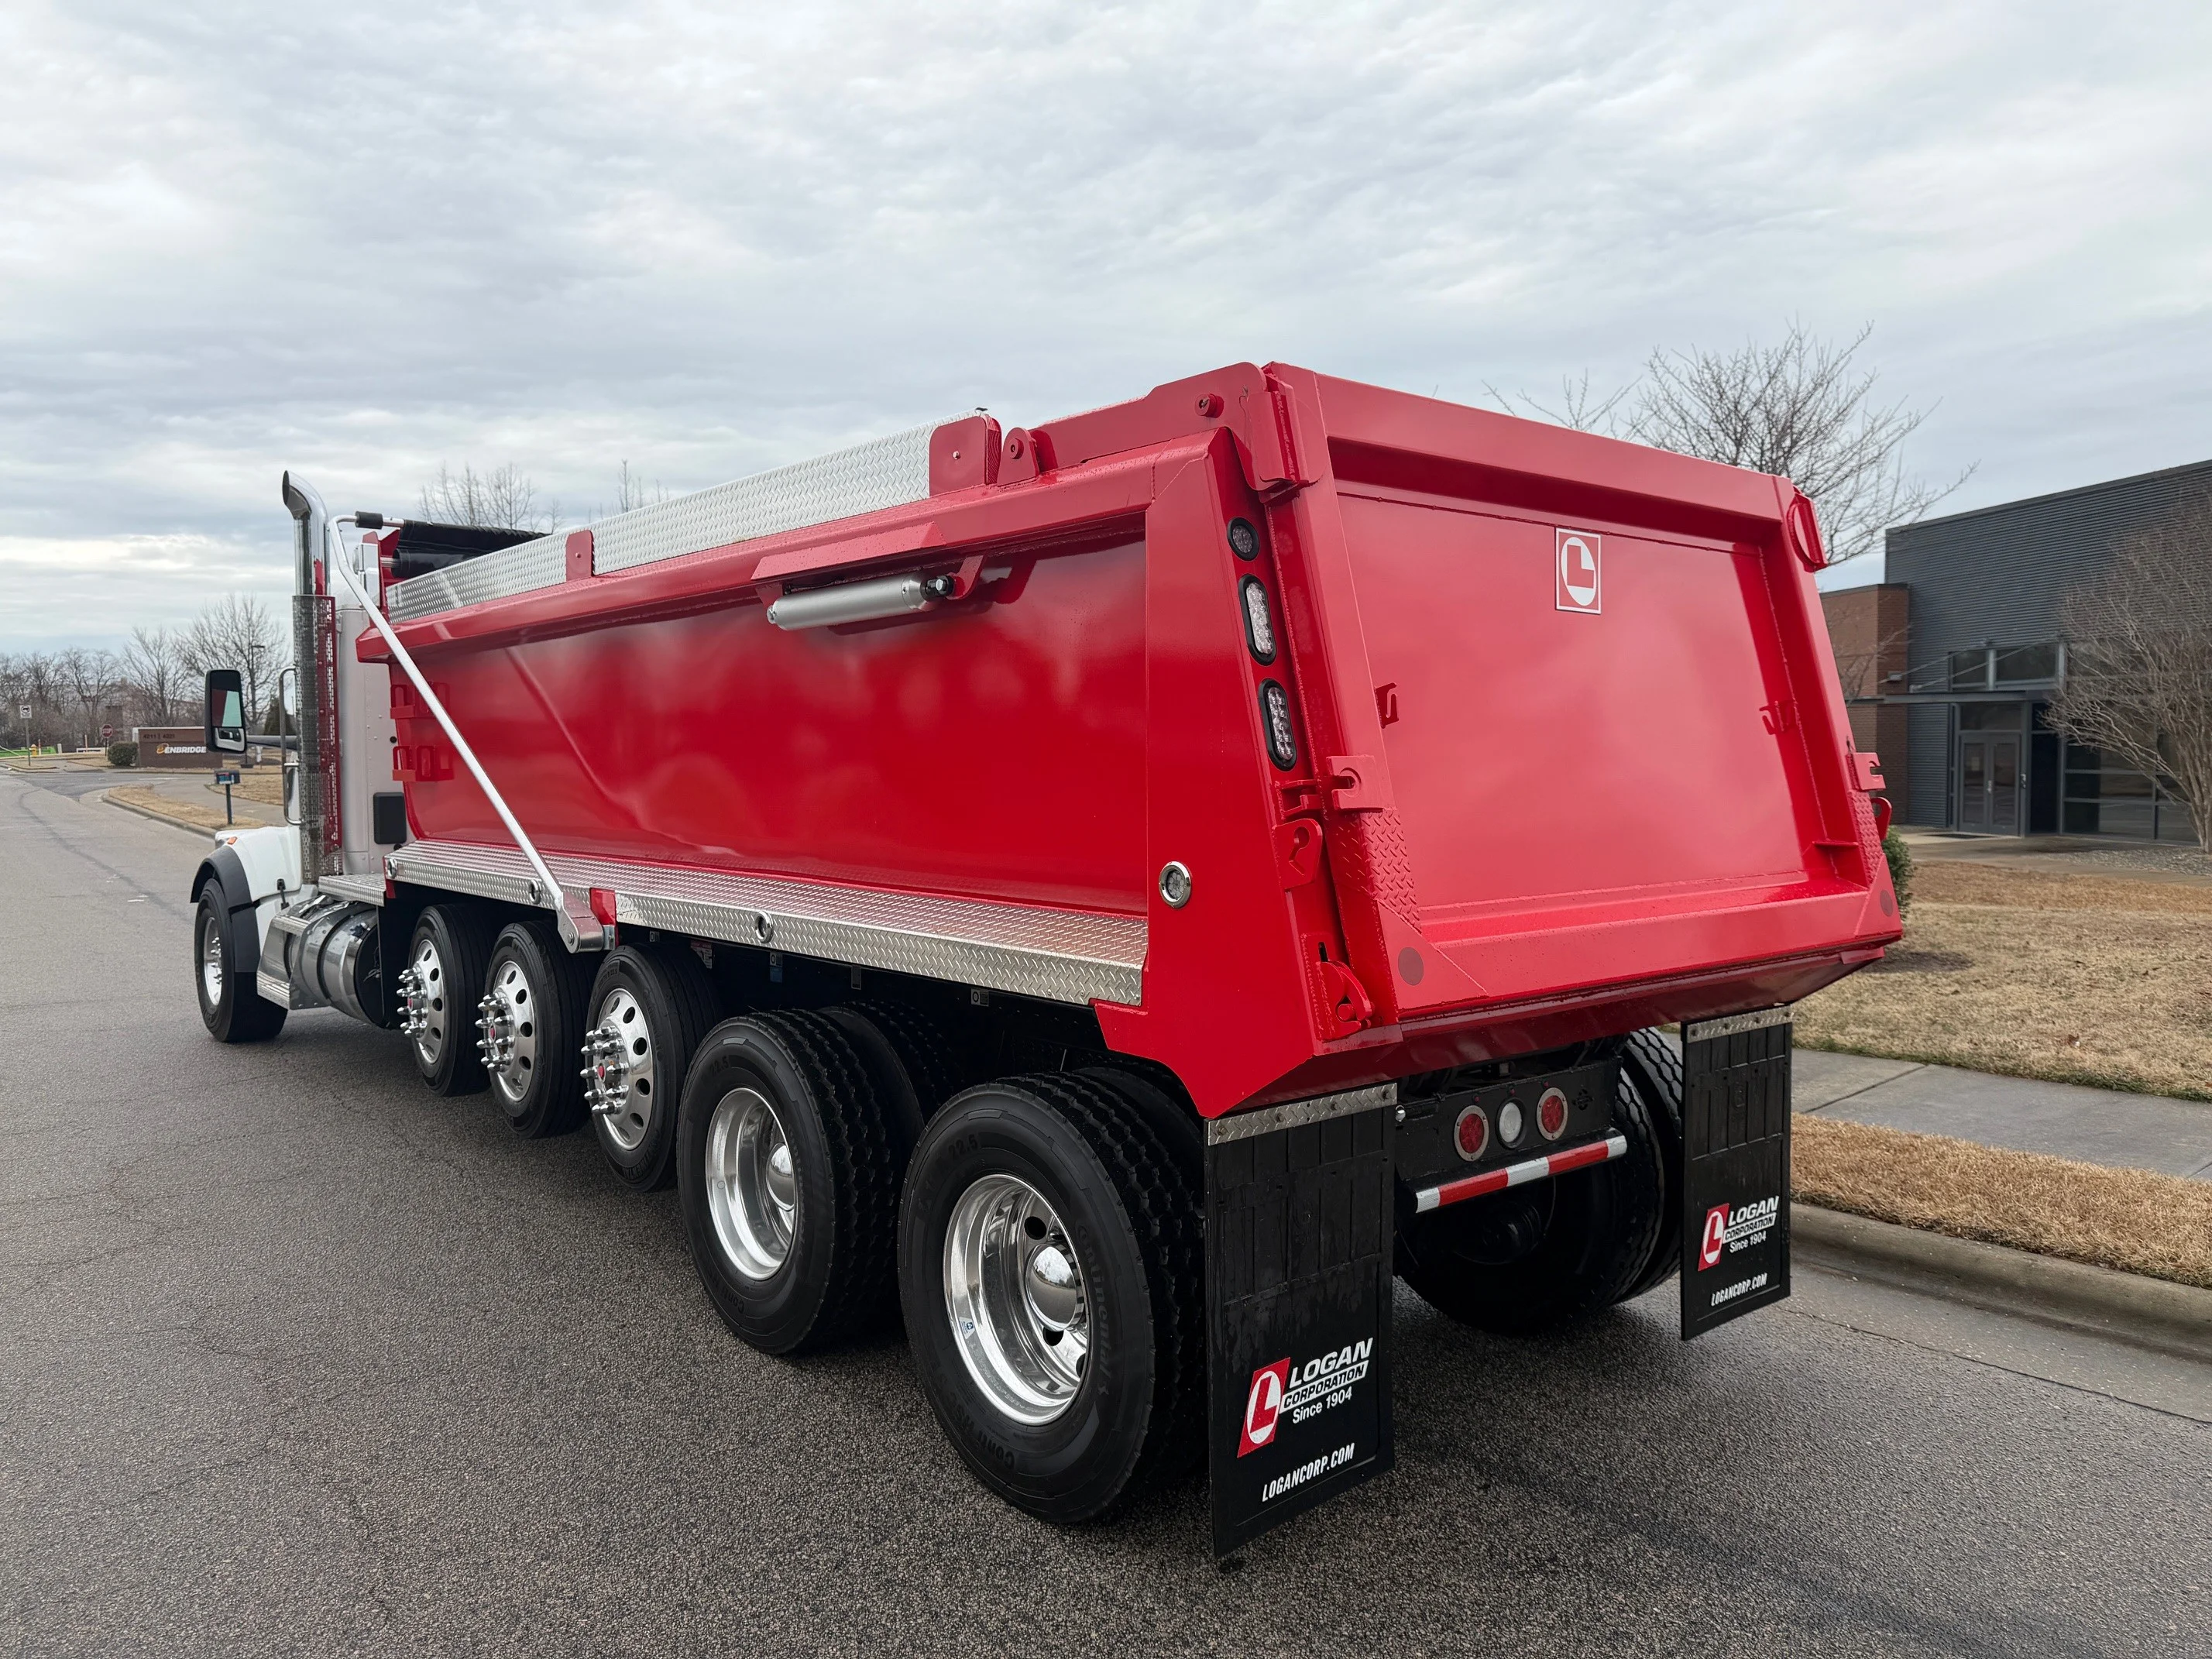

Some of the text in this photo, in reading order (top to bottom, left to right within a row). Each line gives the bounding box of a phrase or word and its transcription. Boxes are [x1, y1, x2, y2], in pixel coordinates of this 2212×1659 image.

[1725, 1214, 1774, 1241] CORPORATION
[1728, 1196, 1780, 1227] LOGAN
[1729, 1231, 1767, 1254] Since 1904
[1711, 1273, 1768, 1307] LOGANCORP.COM
[1289, 1337, 1373, 1389] LOGAN
[1283, 1366, 1365, 1409] CORPORATION
[1292, 1386, 1353, 1424] Since 1904
[1262, 1442, 1356, 1503] LOGANCORP.COM
